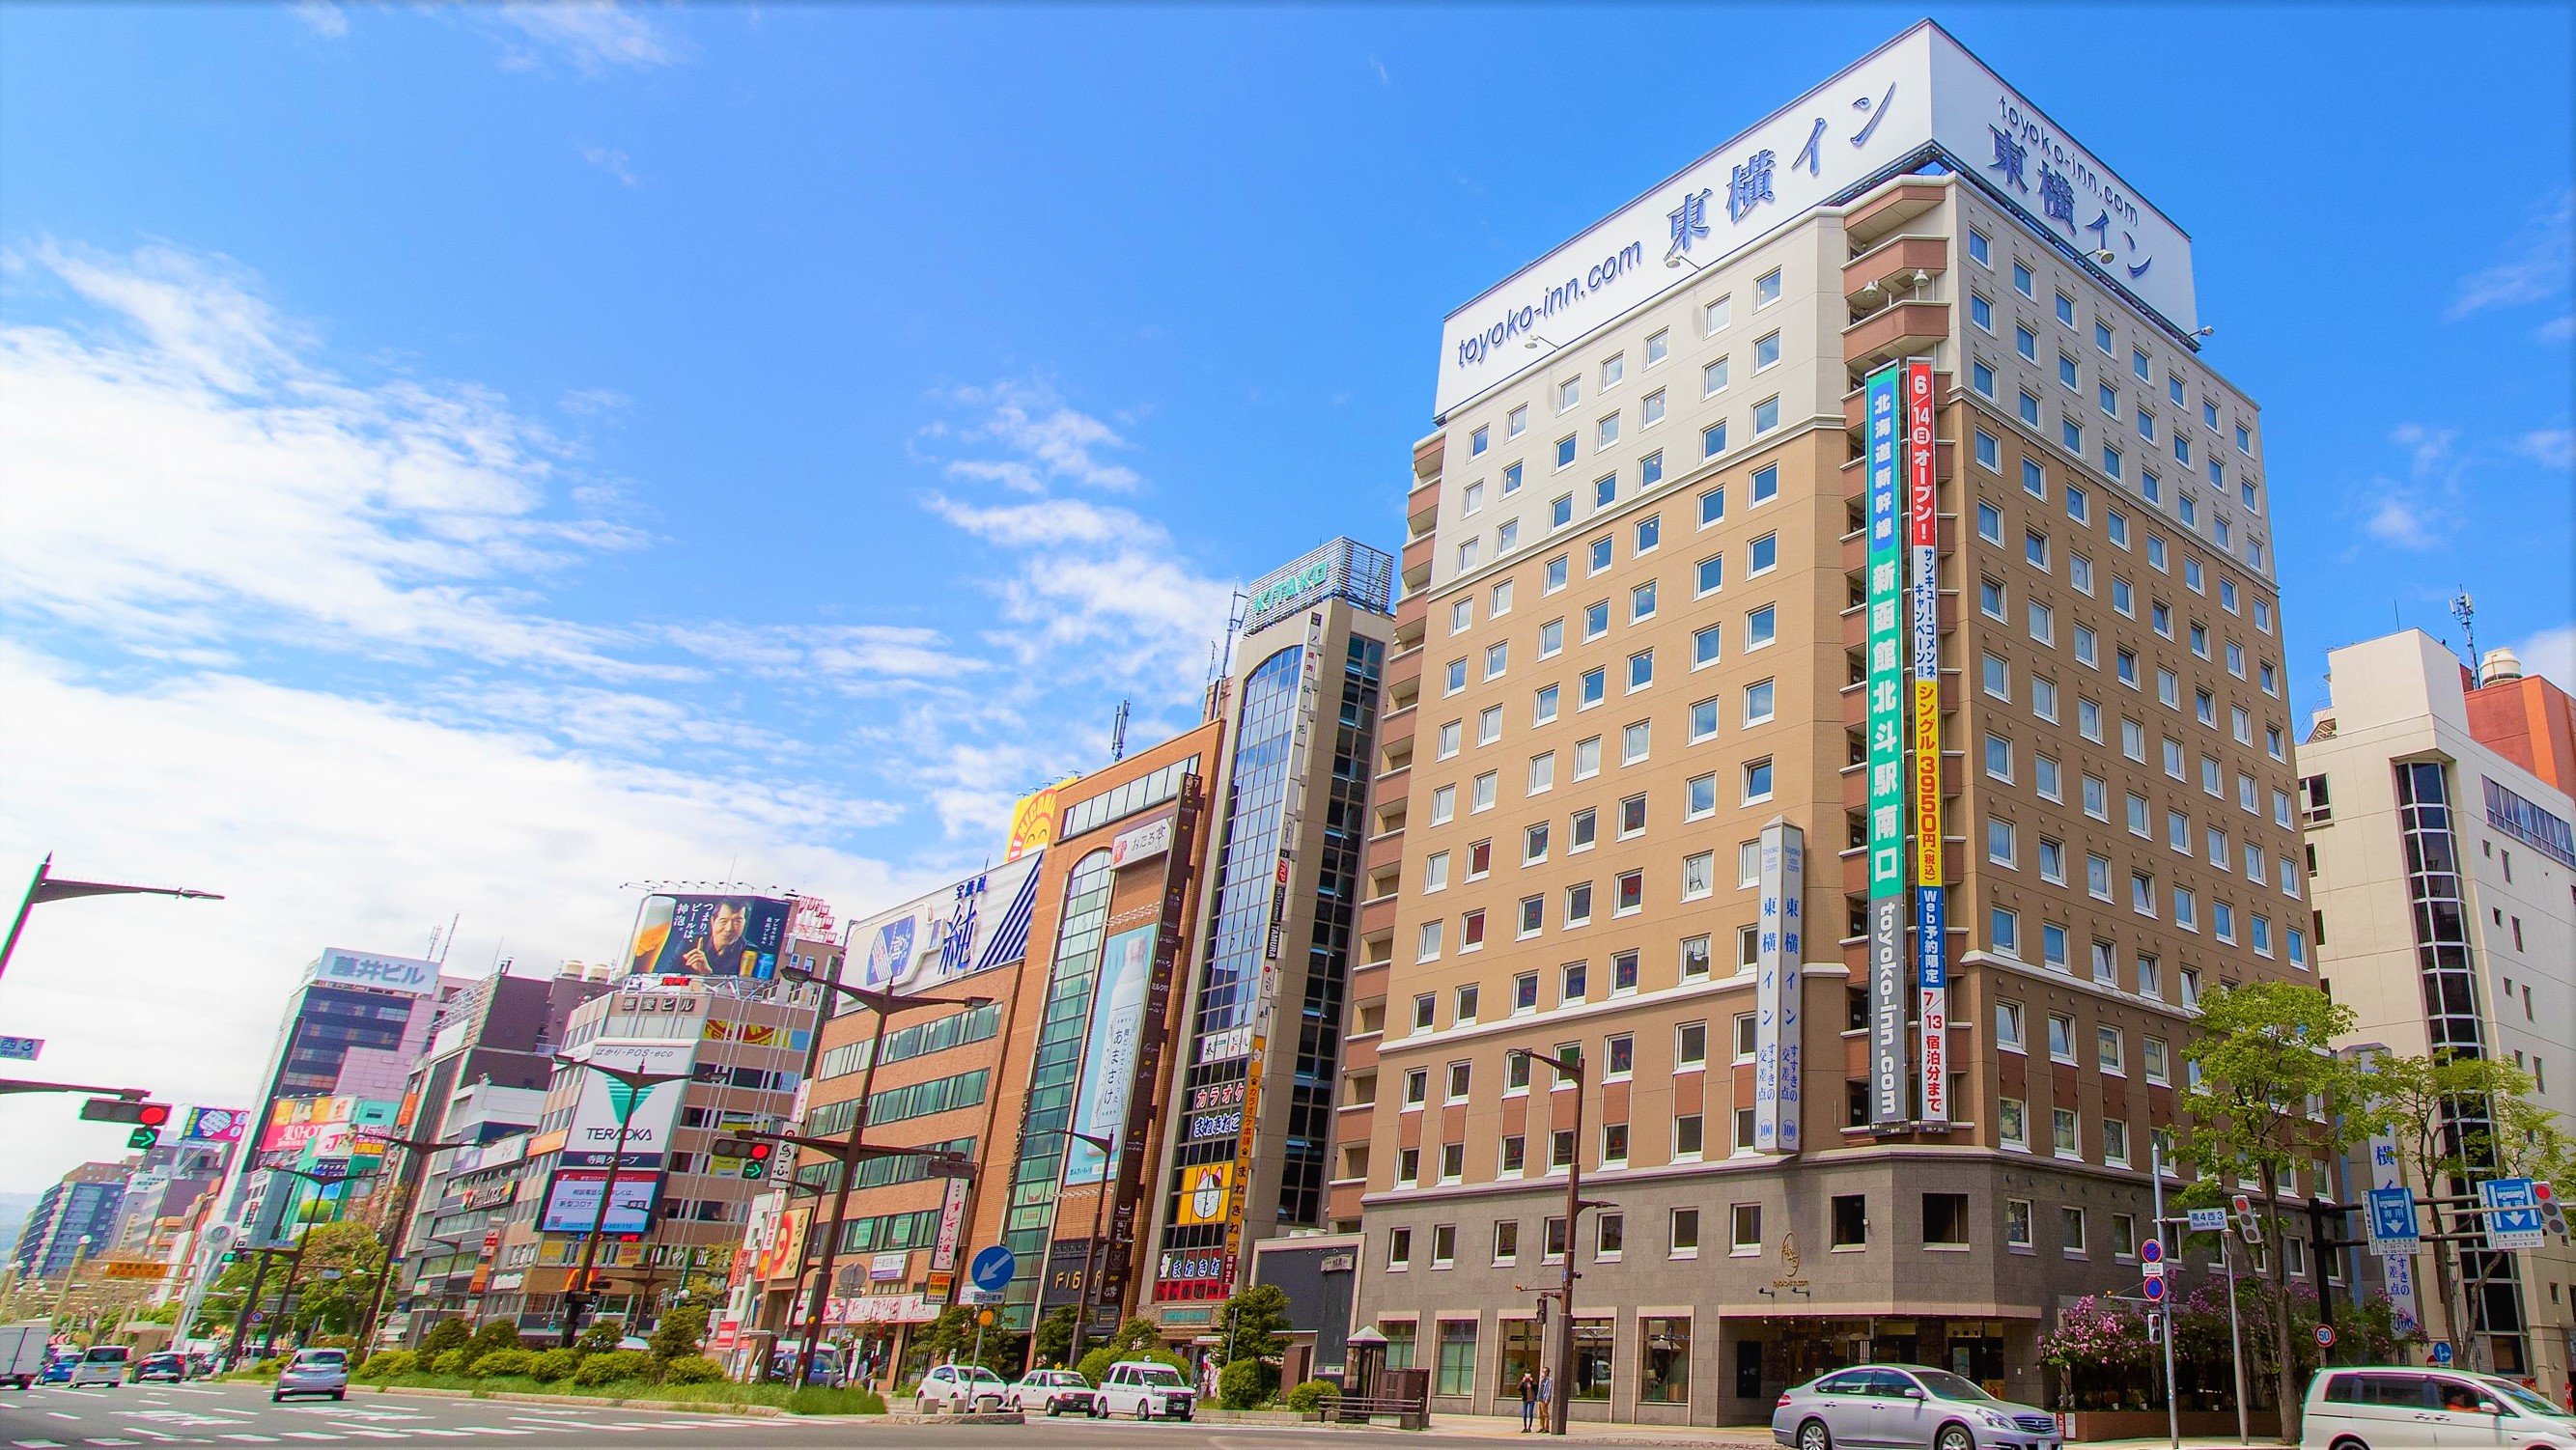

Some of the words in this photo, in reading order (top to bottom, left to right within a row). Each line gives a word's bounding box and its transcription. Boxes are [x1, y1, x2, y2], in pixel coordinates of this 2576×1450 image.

[1665, 81, 1896, 255] 東横イン
[1999, 95, 2140, 226] toyoko-inn.com
[1987, 123, 2153, 278] 東横イン
[1457, 241, 1642, 369] toyoko-inn.com
[1874, 393, 1892, 541] 北海道新幹線
[1254, 562, 1329, 614] KITAKO
[1872, 560, 1898, 882] 新函館北斗駅南口
[1268, 925, 1279, 958] TAMURA
[1761, 897, 1778, 1027] 東横イン
[1783, 897, 1800, 1027] 東横イン
[1878, 902, 1897, 1115] toyoko-inn.com
[1196, 1082, 1245, 1109] カラオケ
[1757, 1048, 1768, 1101] 交差点
[1767, 1043, 1776, 1101] すすきの
[1780, 1048, 1790, 1102] 交差点
[1790, 1044, 1799, 1102] すすきの
[1193, 1111, 1241, 1138] まねきねこ
[1759, 1123, 1773, 1137] 100
[1782, 1124, 1796, 1138] 100
[1226, 1165, 1247, 1254] まねきねこ
[2318, 1330, 2331, 1342] 50
